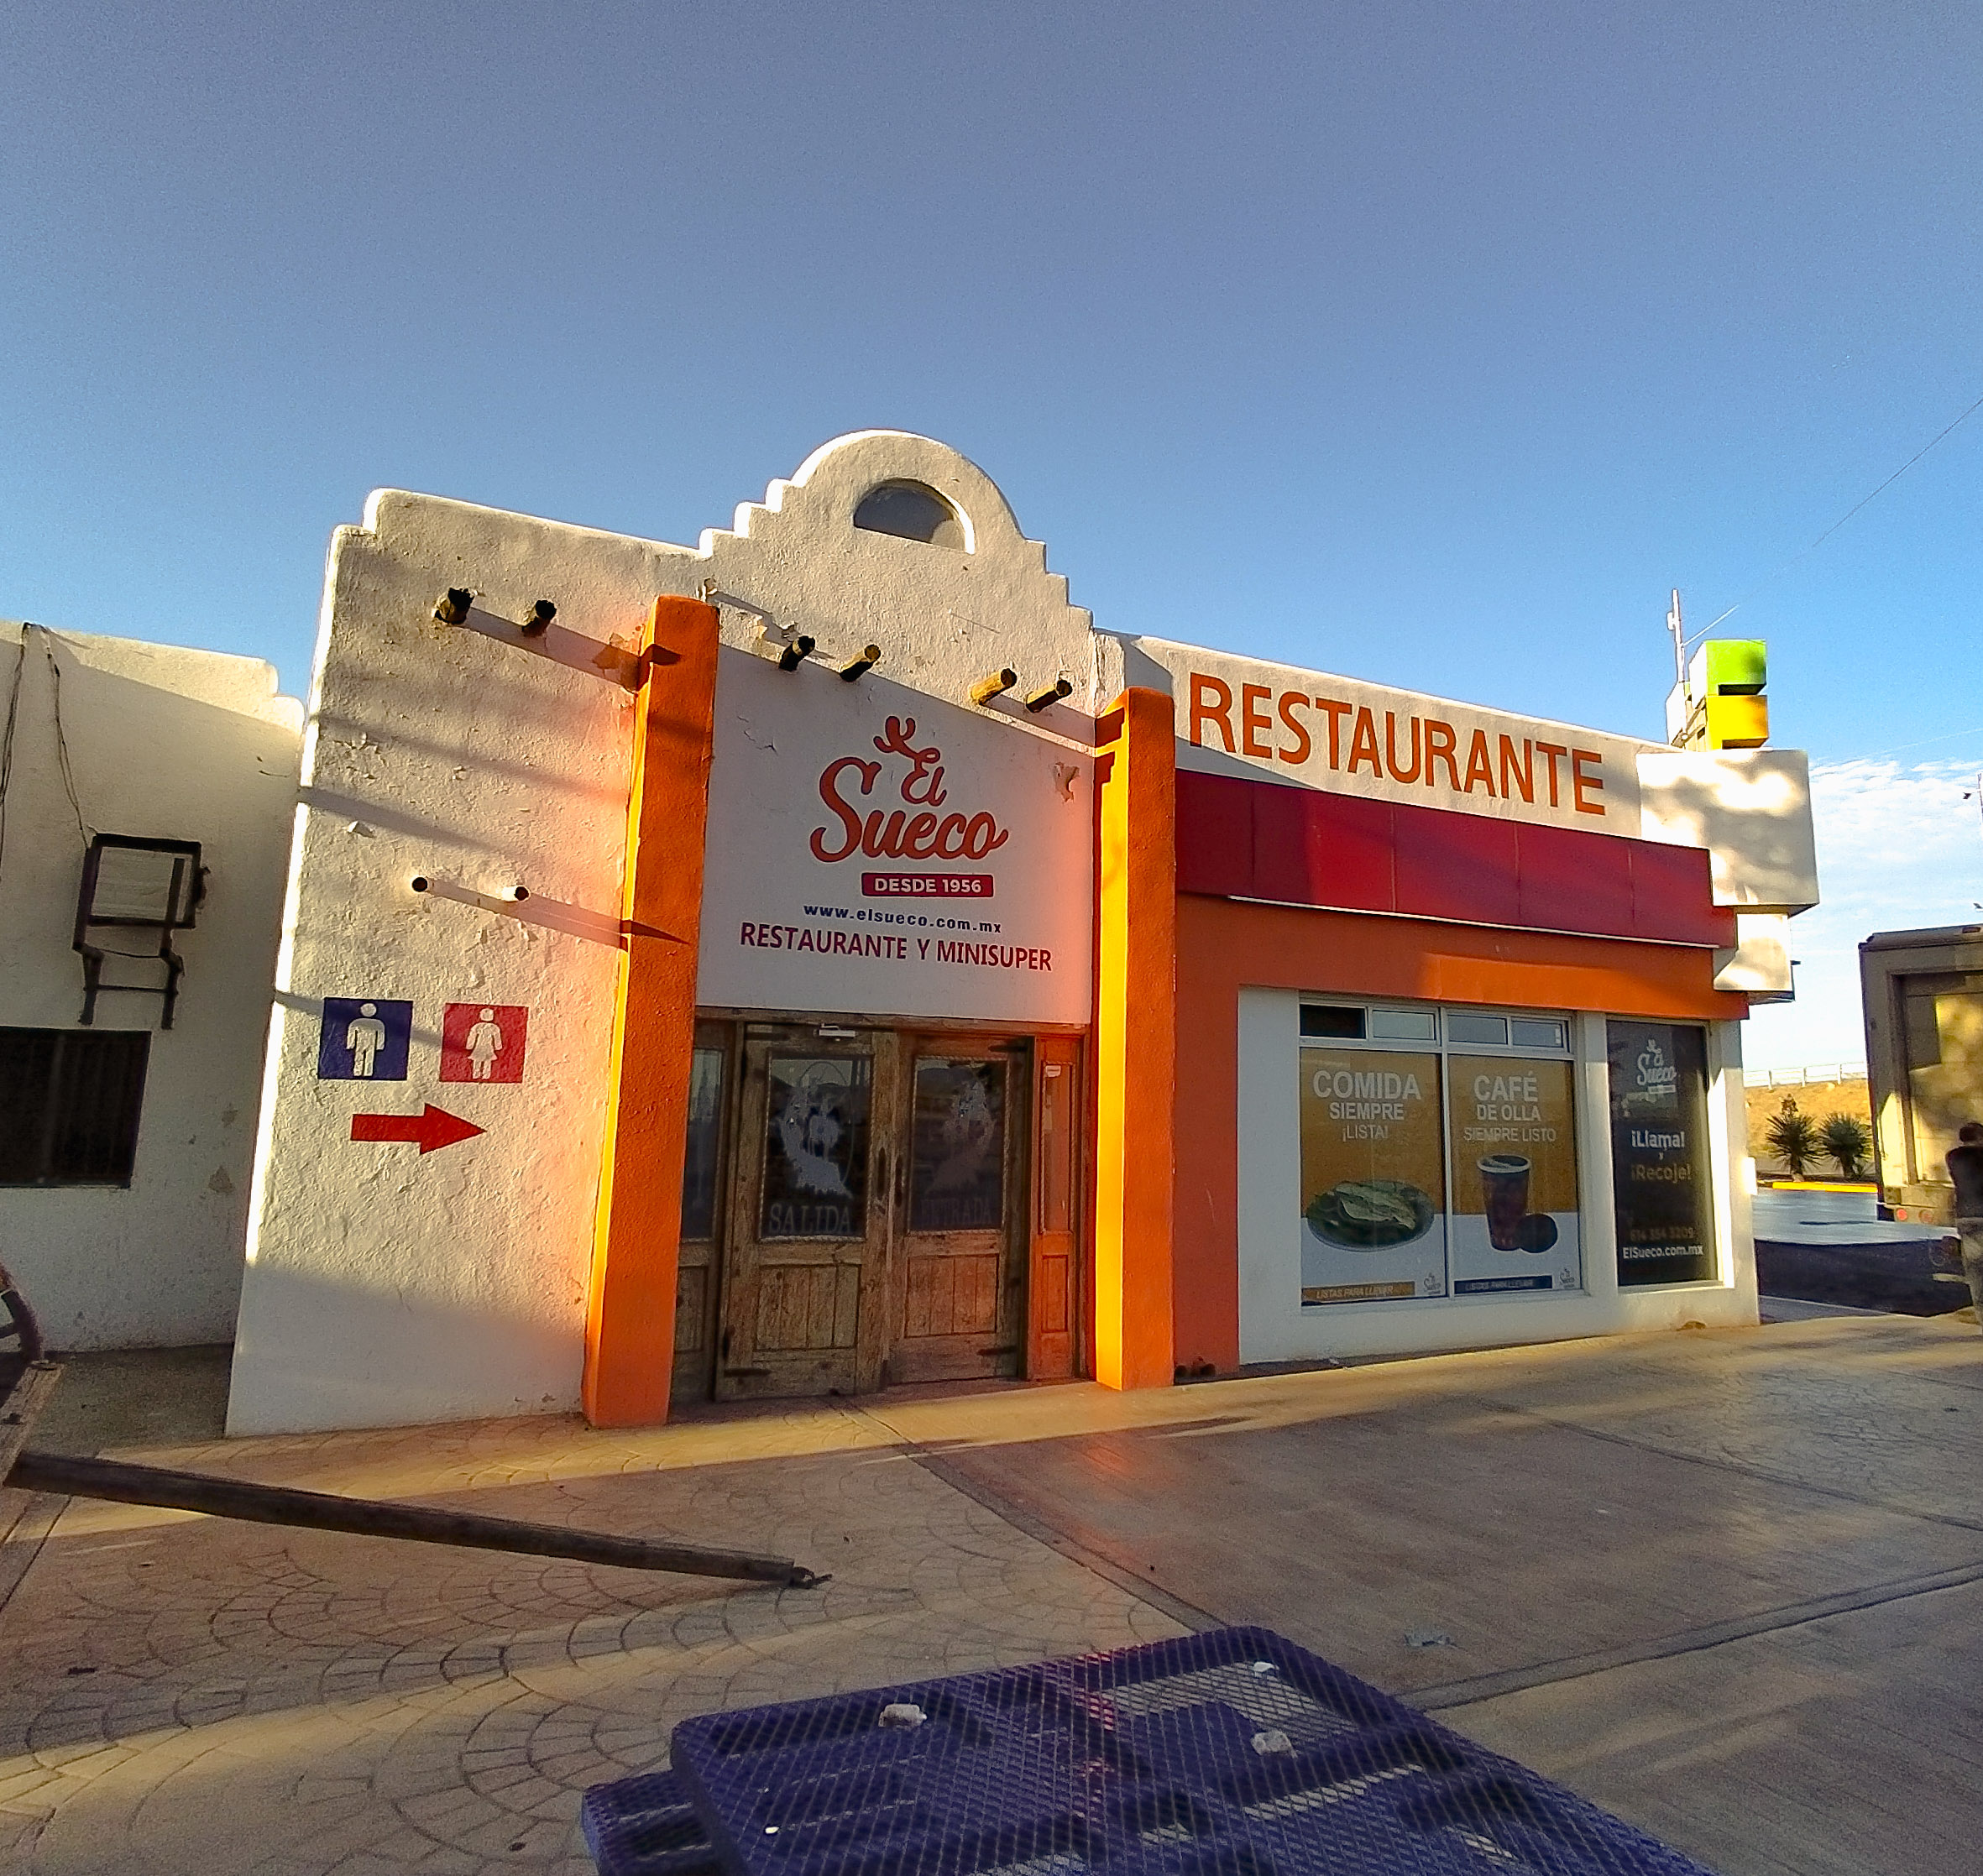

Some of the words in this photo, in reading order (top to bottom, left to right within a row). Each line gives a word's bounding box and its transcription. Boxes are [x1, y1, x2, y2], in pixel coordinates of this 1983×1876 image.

[1189, 671, 1606, 817] RESTAURANTE
[895, 745, 948, 807] El
[809, 756, 1009, 863] Sueco
[874, 877, 937, 894] DESDE
[942, 878, 982, 894] 1956
[803, 903, 1002, 934] www.elsueco.com.mx
[740, 921, 908, 959] RESTAURANTE
[916, 938, 931, 960] Y
[936, 939, 1053, 972] MINISUPER
[1312, 1069, 1422, 1101] COMIDA
[1636, 1053, 1677, 1086] Sueco
[1473, 1070, 1539, 1103] CAFÉ
[1329, 1102, 1405, 1121] SIEMPRE
[1477, 1104, 1499, 1121] DE
[1501, 1104, 1542, 1122] OLLA
[1462, 1126, 1520, 1142] SIEMPRE
[1521, 1128, 1557, 1143] LISTO
[767, 1201, 853, 1235] SALIDA
[919, 1196, 993, 1228] ENTRADA
[1622, 1245, 1704, 1260] ElSueco.com.mx
[1316, 1288, 1343, 1299] LISTAS
